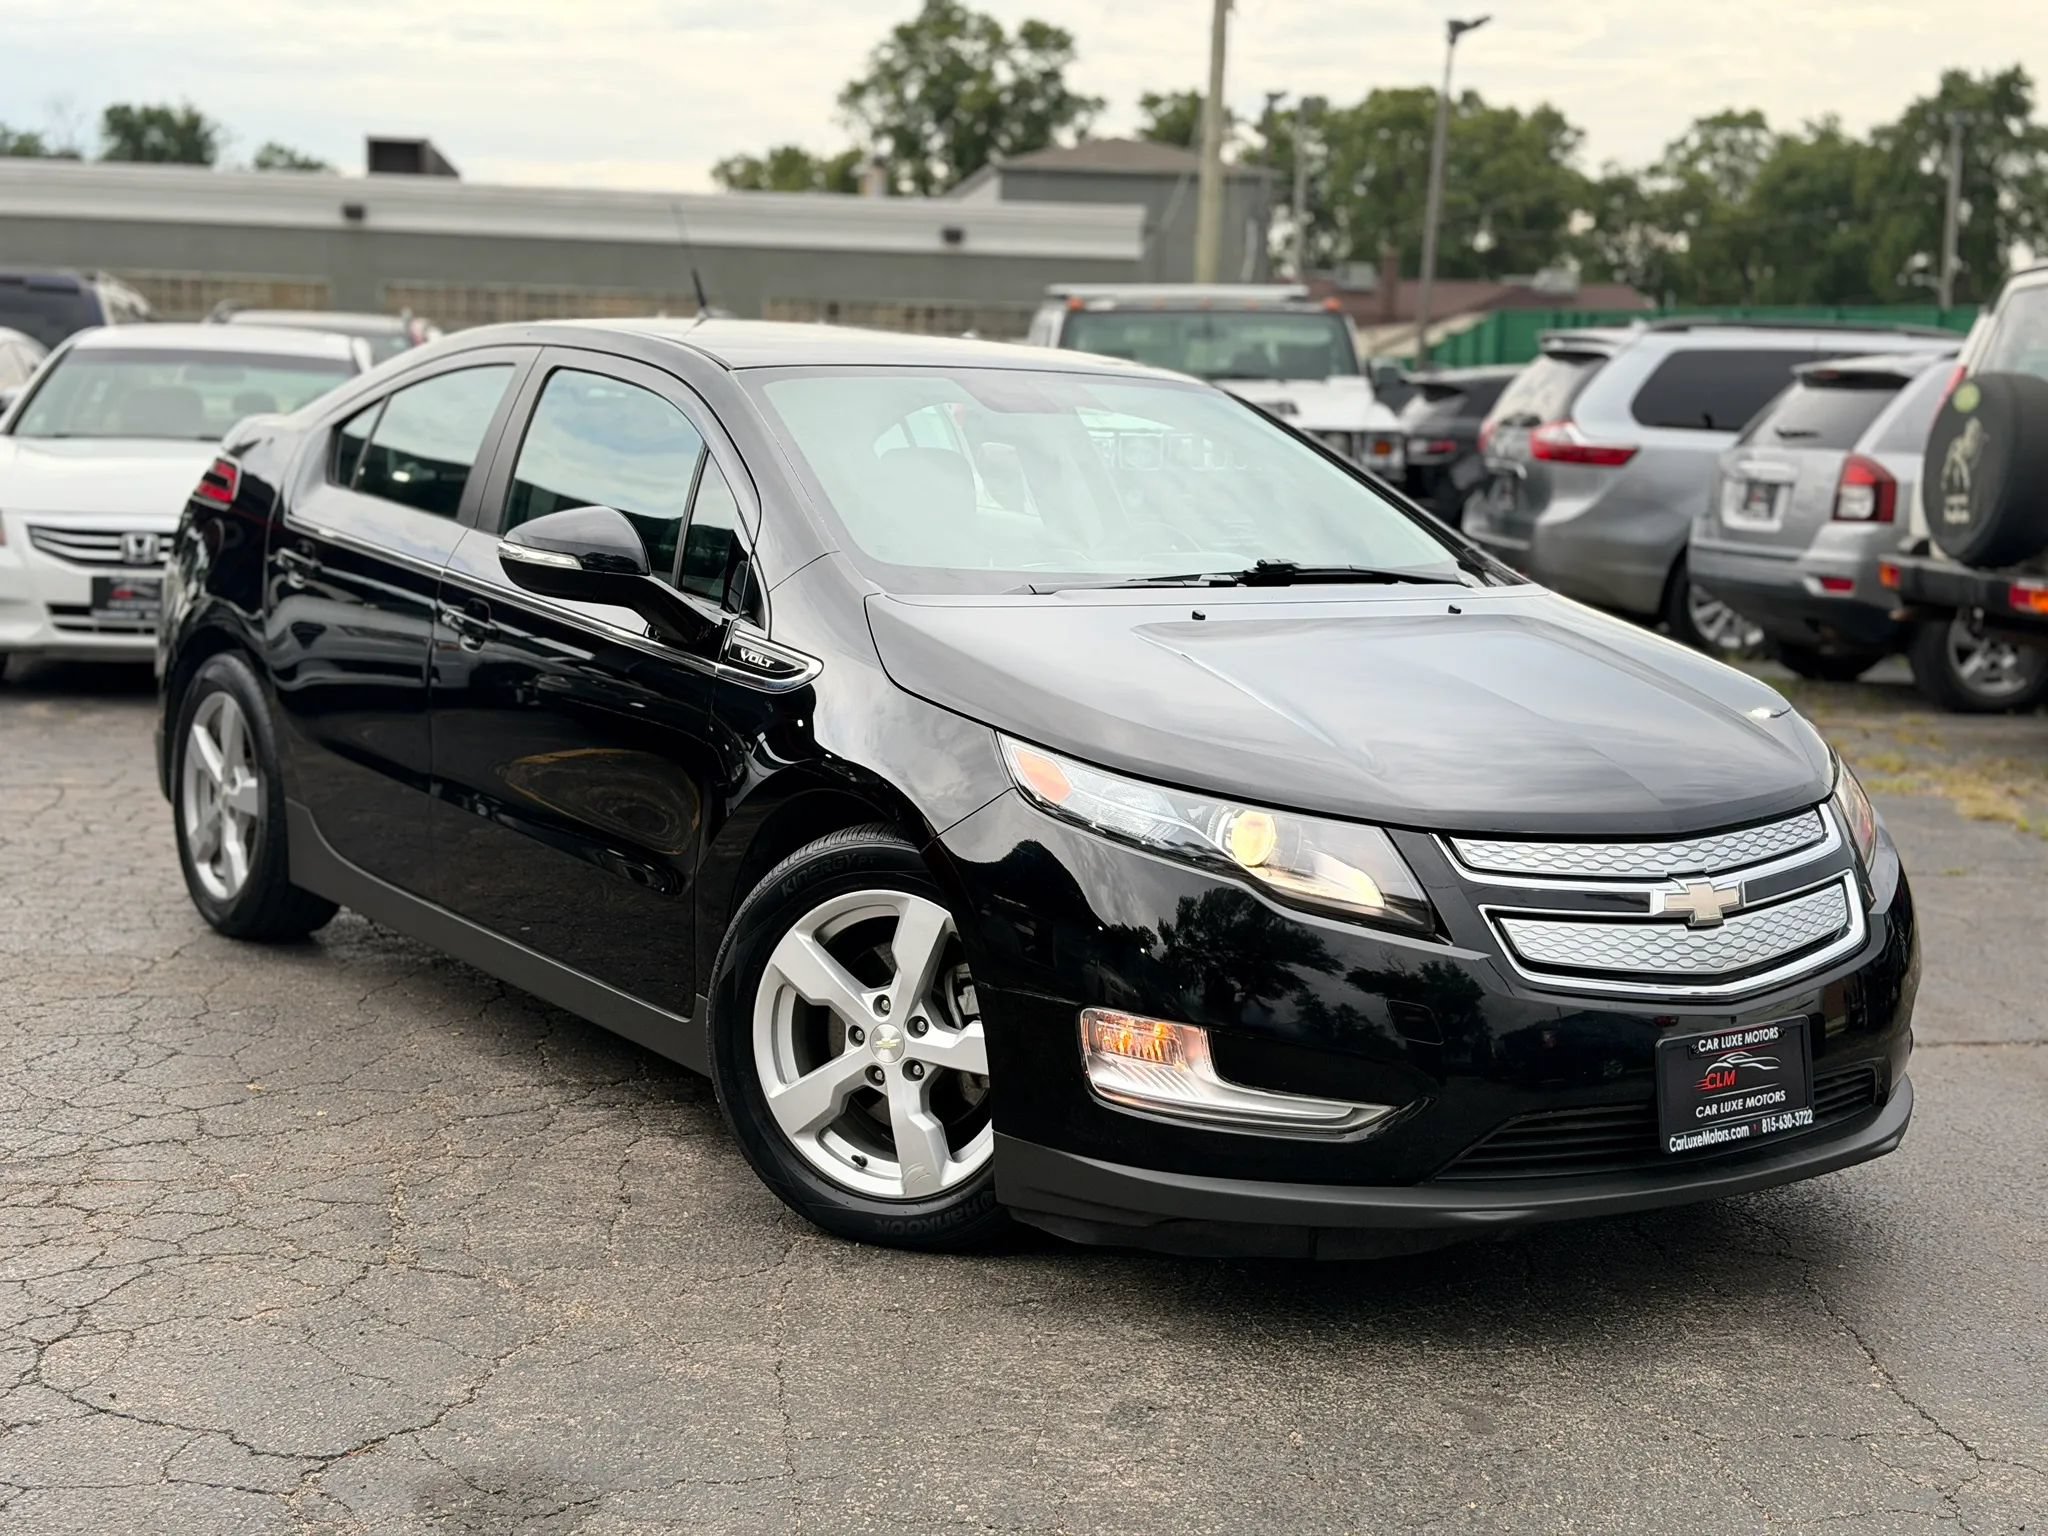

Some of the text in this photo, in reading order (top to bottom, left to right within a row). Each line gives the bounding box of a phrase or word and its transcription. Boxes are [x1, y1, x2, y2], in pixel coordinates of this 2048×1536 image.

[740, 647, 775, 668] VOLT
[1698, 1027, 1779, 1053] CAR LUXE MOTORS
[1706, 1070, 1737, 1089] CLM
[1696, 1090, 1786, 1118] CAR LUXE MOTORS
[1669, 1109, 1814, 1153] CarLuxeMotors.com 815-630-3722
